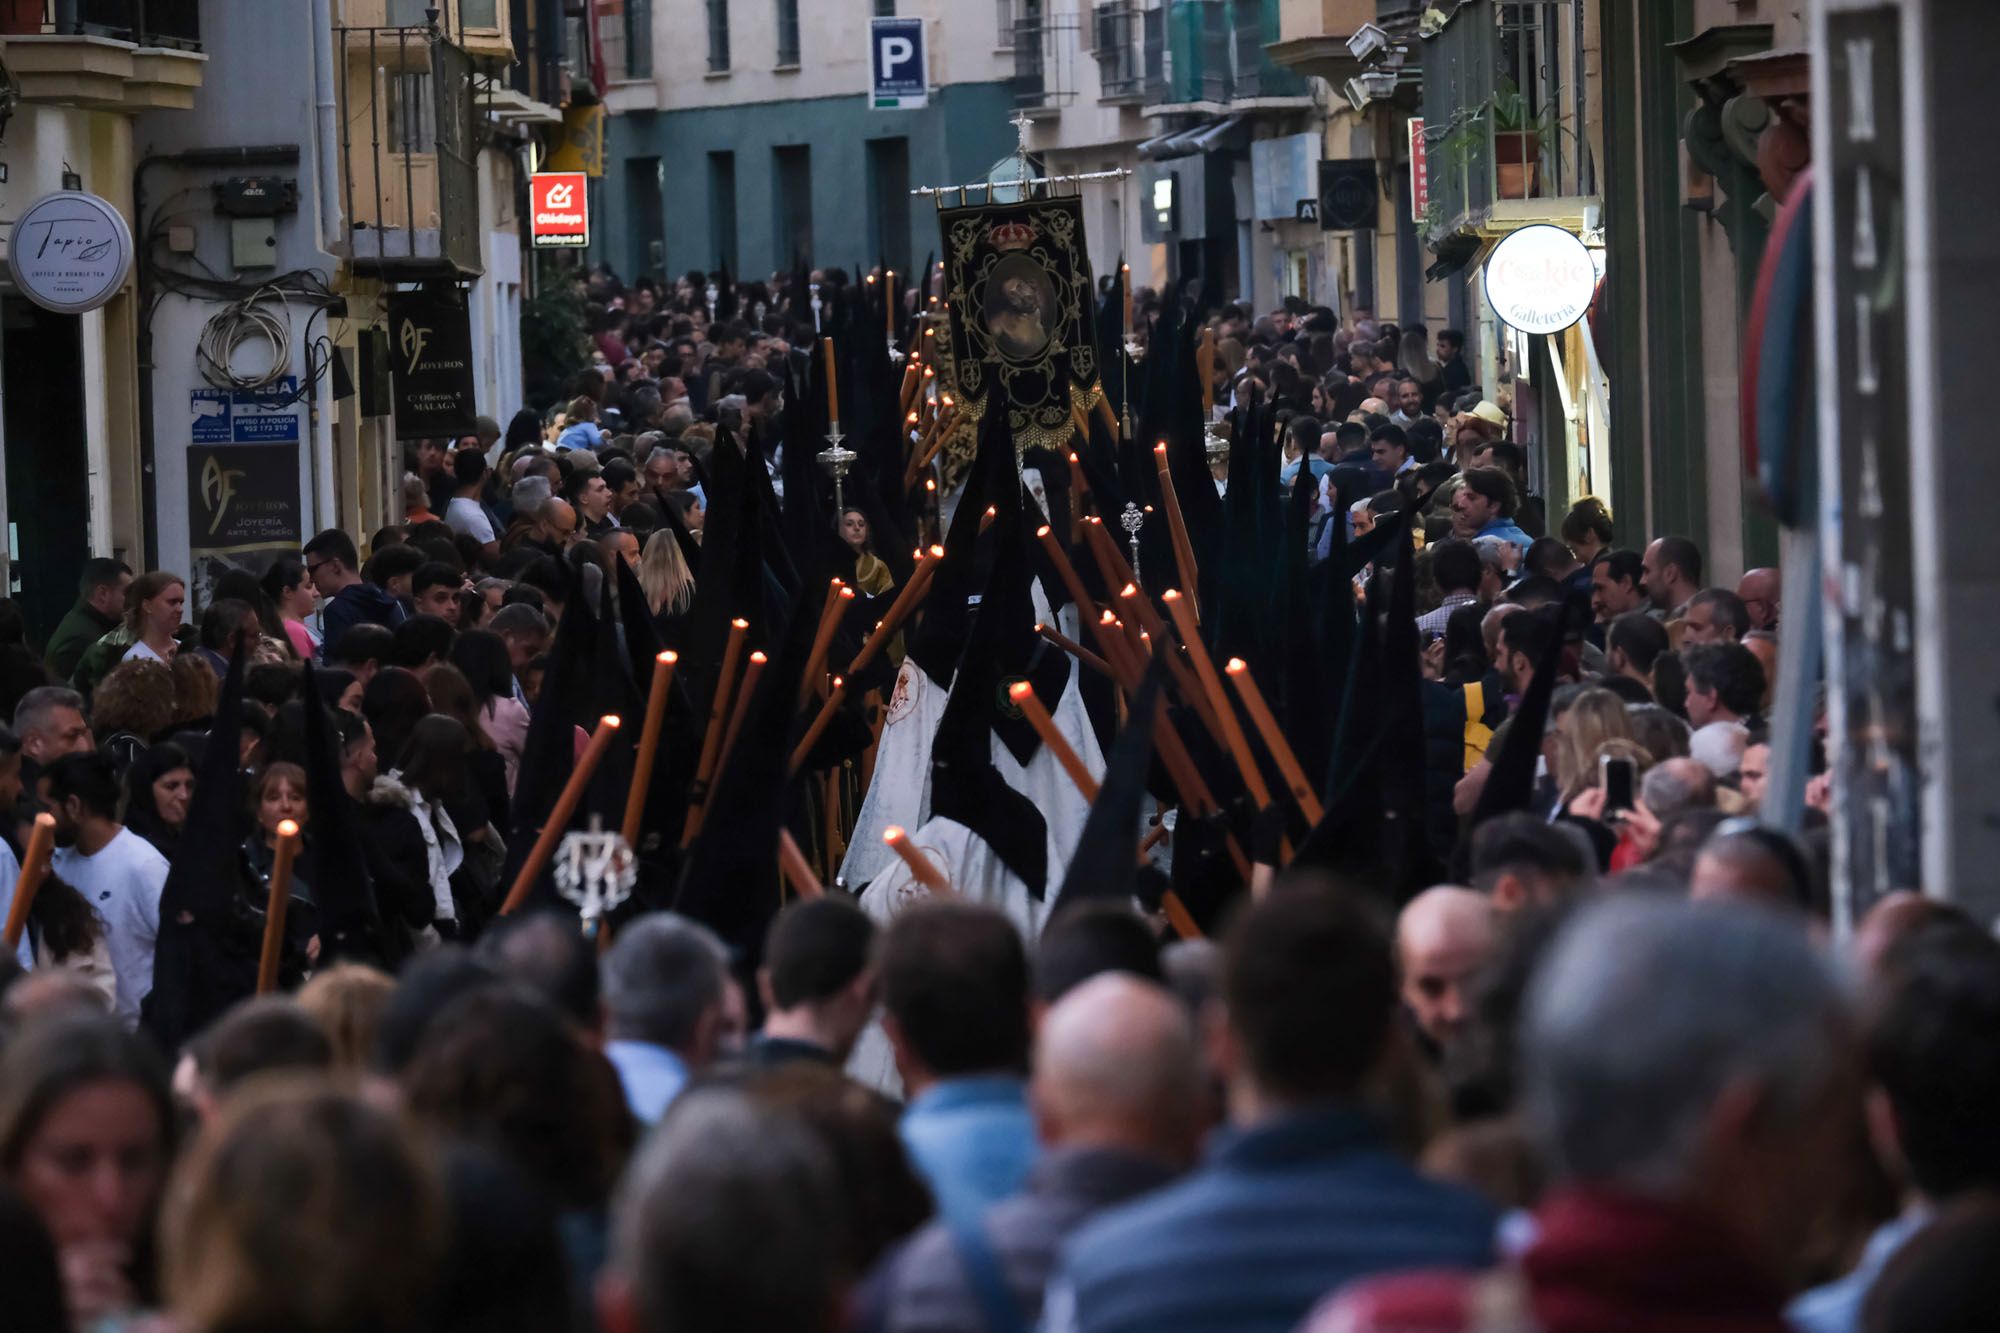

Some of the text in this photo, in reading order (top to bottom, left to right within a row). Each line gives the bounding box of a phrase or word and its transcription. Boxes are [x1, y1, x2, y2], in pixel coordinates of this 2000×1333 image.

[881, 37, 913, 79] P
[29, 218, 97, 260] Tapio
[419, 359, 464, 370] JOYEROS
[235, 417, 258, 425] AVISO
